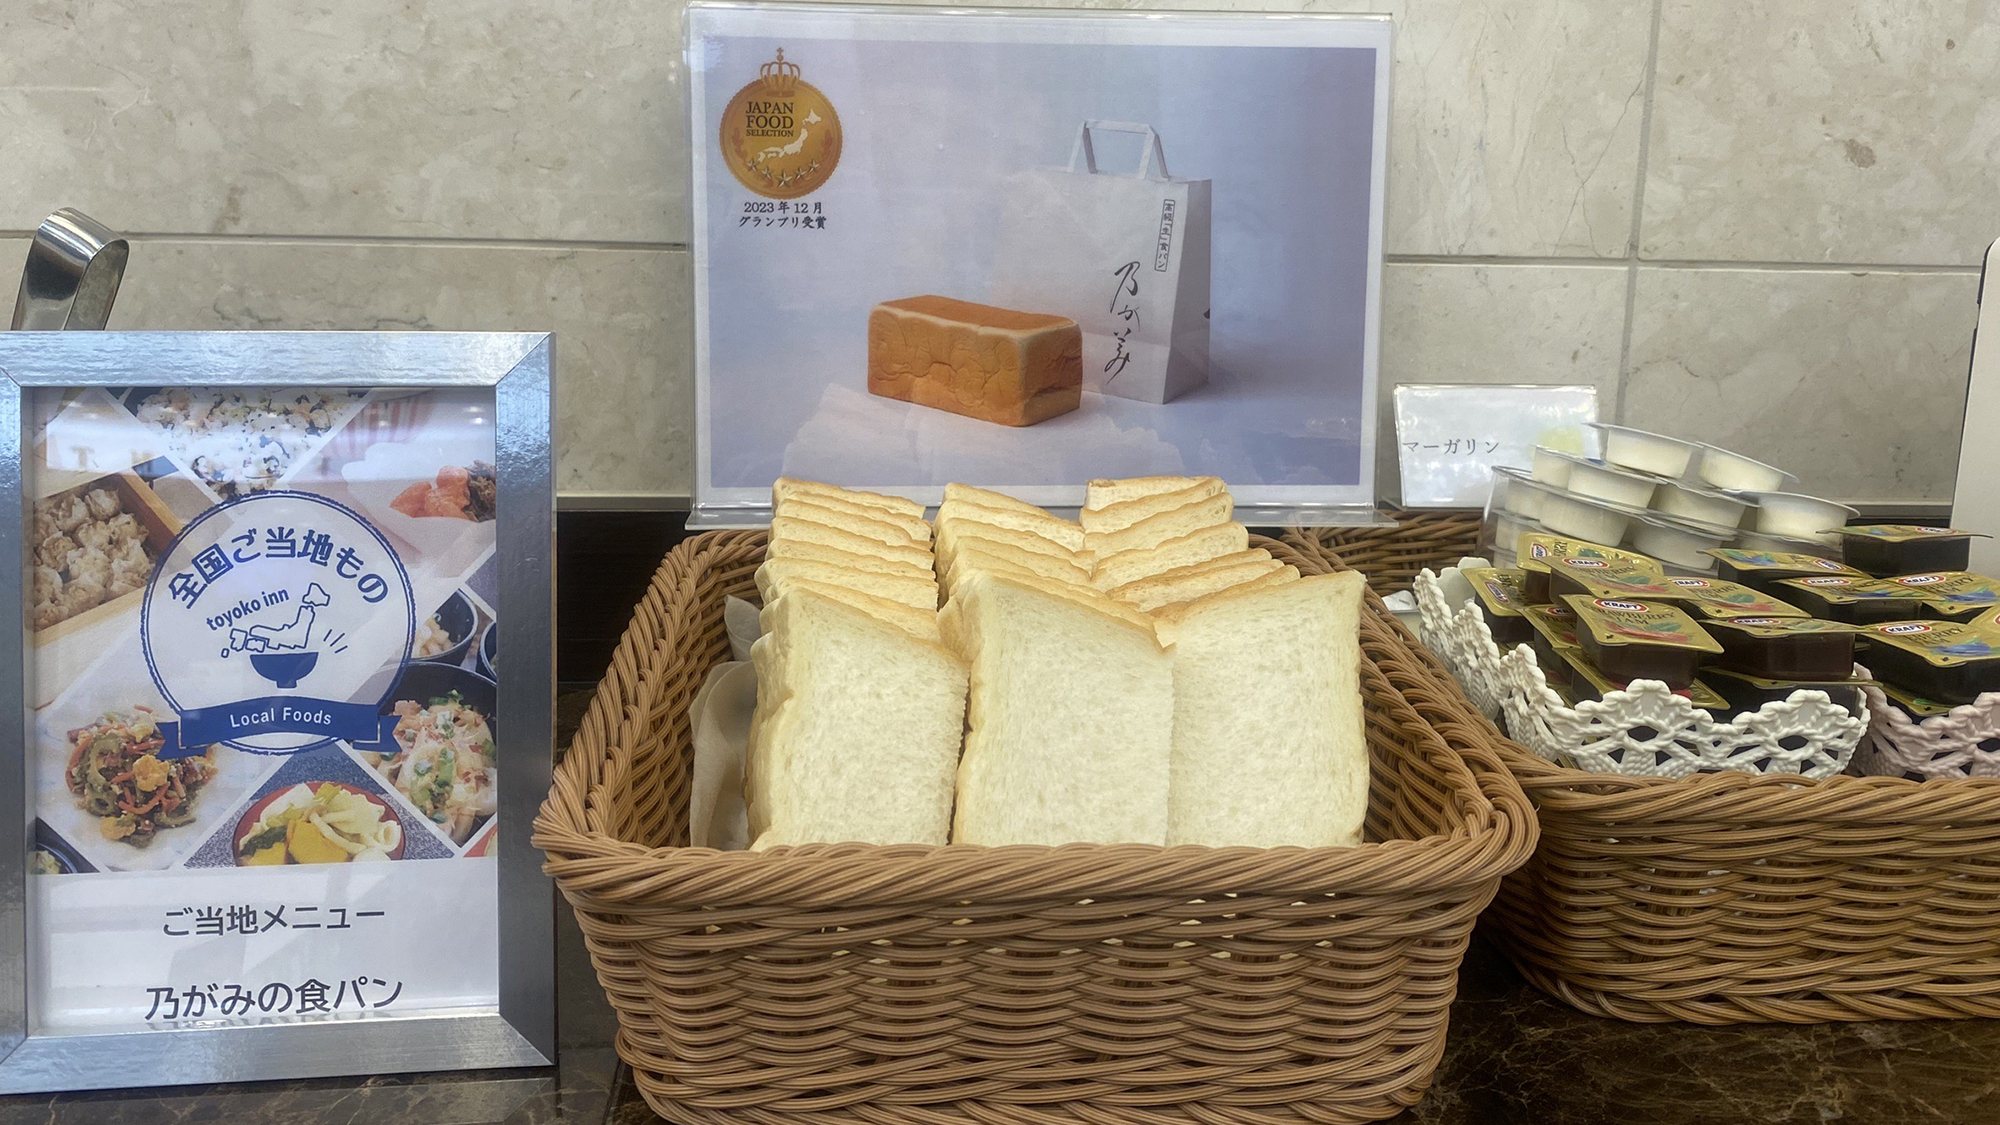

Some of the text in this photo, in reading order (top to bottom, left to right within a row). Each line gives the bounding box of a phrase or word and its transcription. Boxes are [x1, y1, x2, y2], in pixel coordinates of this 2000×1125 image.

[745, 101, 794, 114] JAPAN
[746, 115, 794, 129] FOOD
[746, 129, 794, 137] SELECTION
[1402, 438, 1500, 456] マーガリン
[168, 526, 389, 609] 全国ご当地もの
[206, 588, 290, 631] toyoko inn
[1604, 601, 1639, 609] KRAFT
[1888, 624, 1921, 632] KRAFT
[229, 707, 332, 728] Local Foods
[162, 904, 385, 936] ご当地メニュー
[144, 975, 403, 1020] 乃がみの食パン
